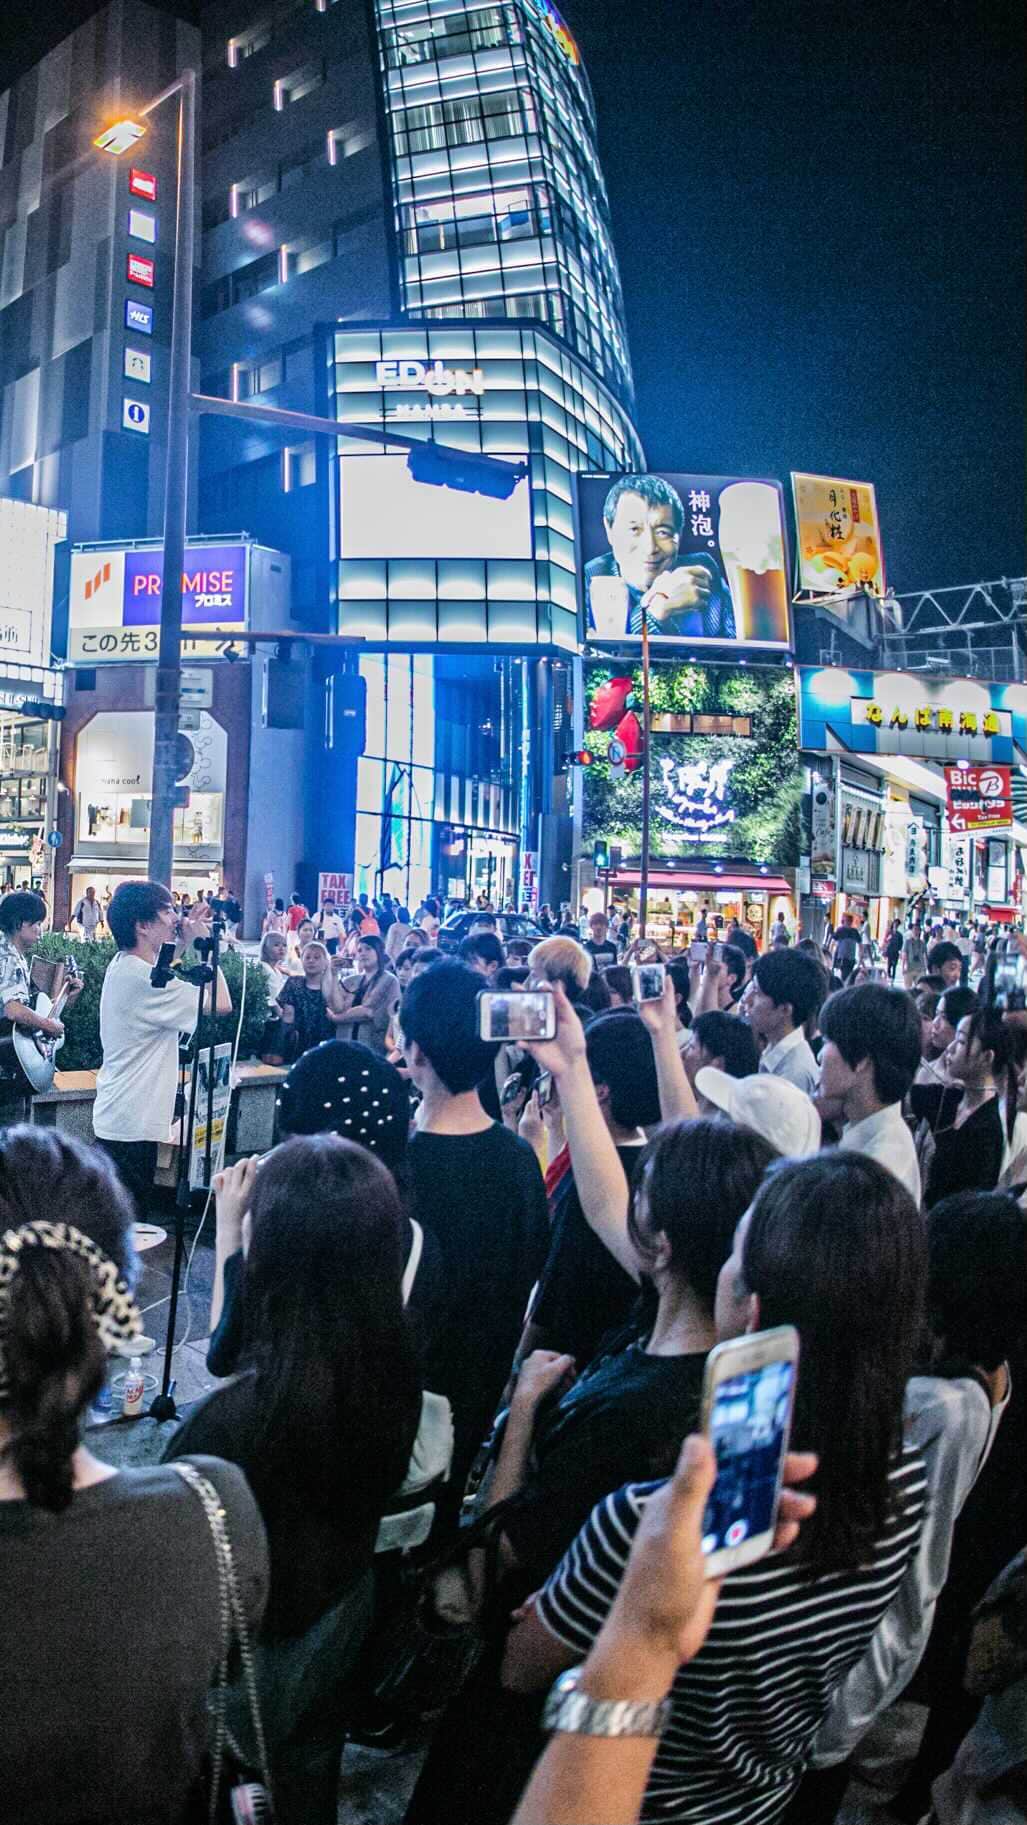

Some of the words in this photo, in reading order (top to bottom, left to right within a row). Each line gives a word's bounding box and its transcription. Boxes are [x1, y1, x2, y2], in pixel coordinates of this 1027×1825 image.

[688, 490, 715, 548] 神泡。
[133, 571, 234, 596] PRMISE
[194, 593, 233, 608] プロミス
[950, 770, 977, 785] Bic
[321, 875, 347, 888] TAX
[320, 890, 350, 905] FREE
